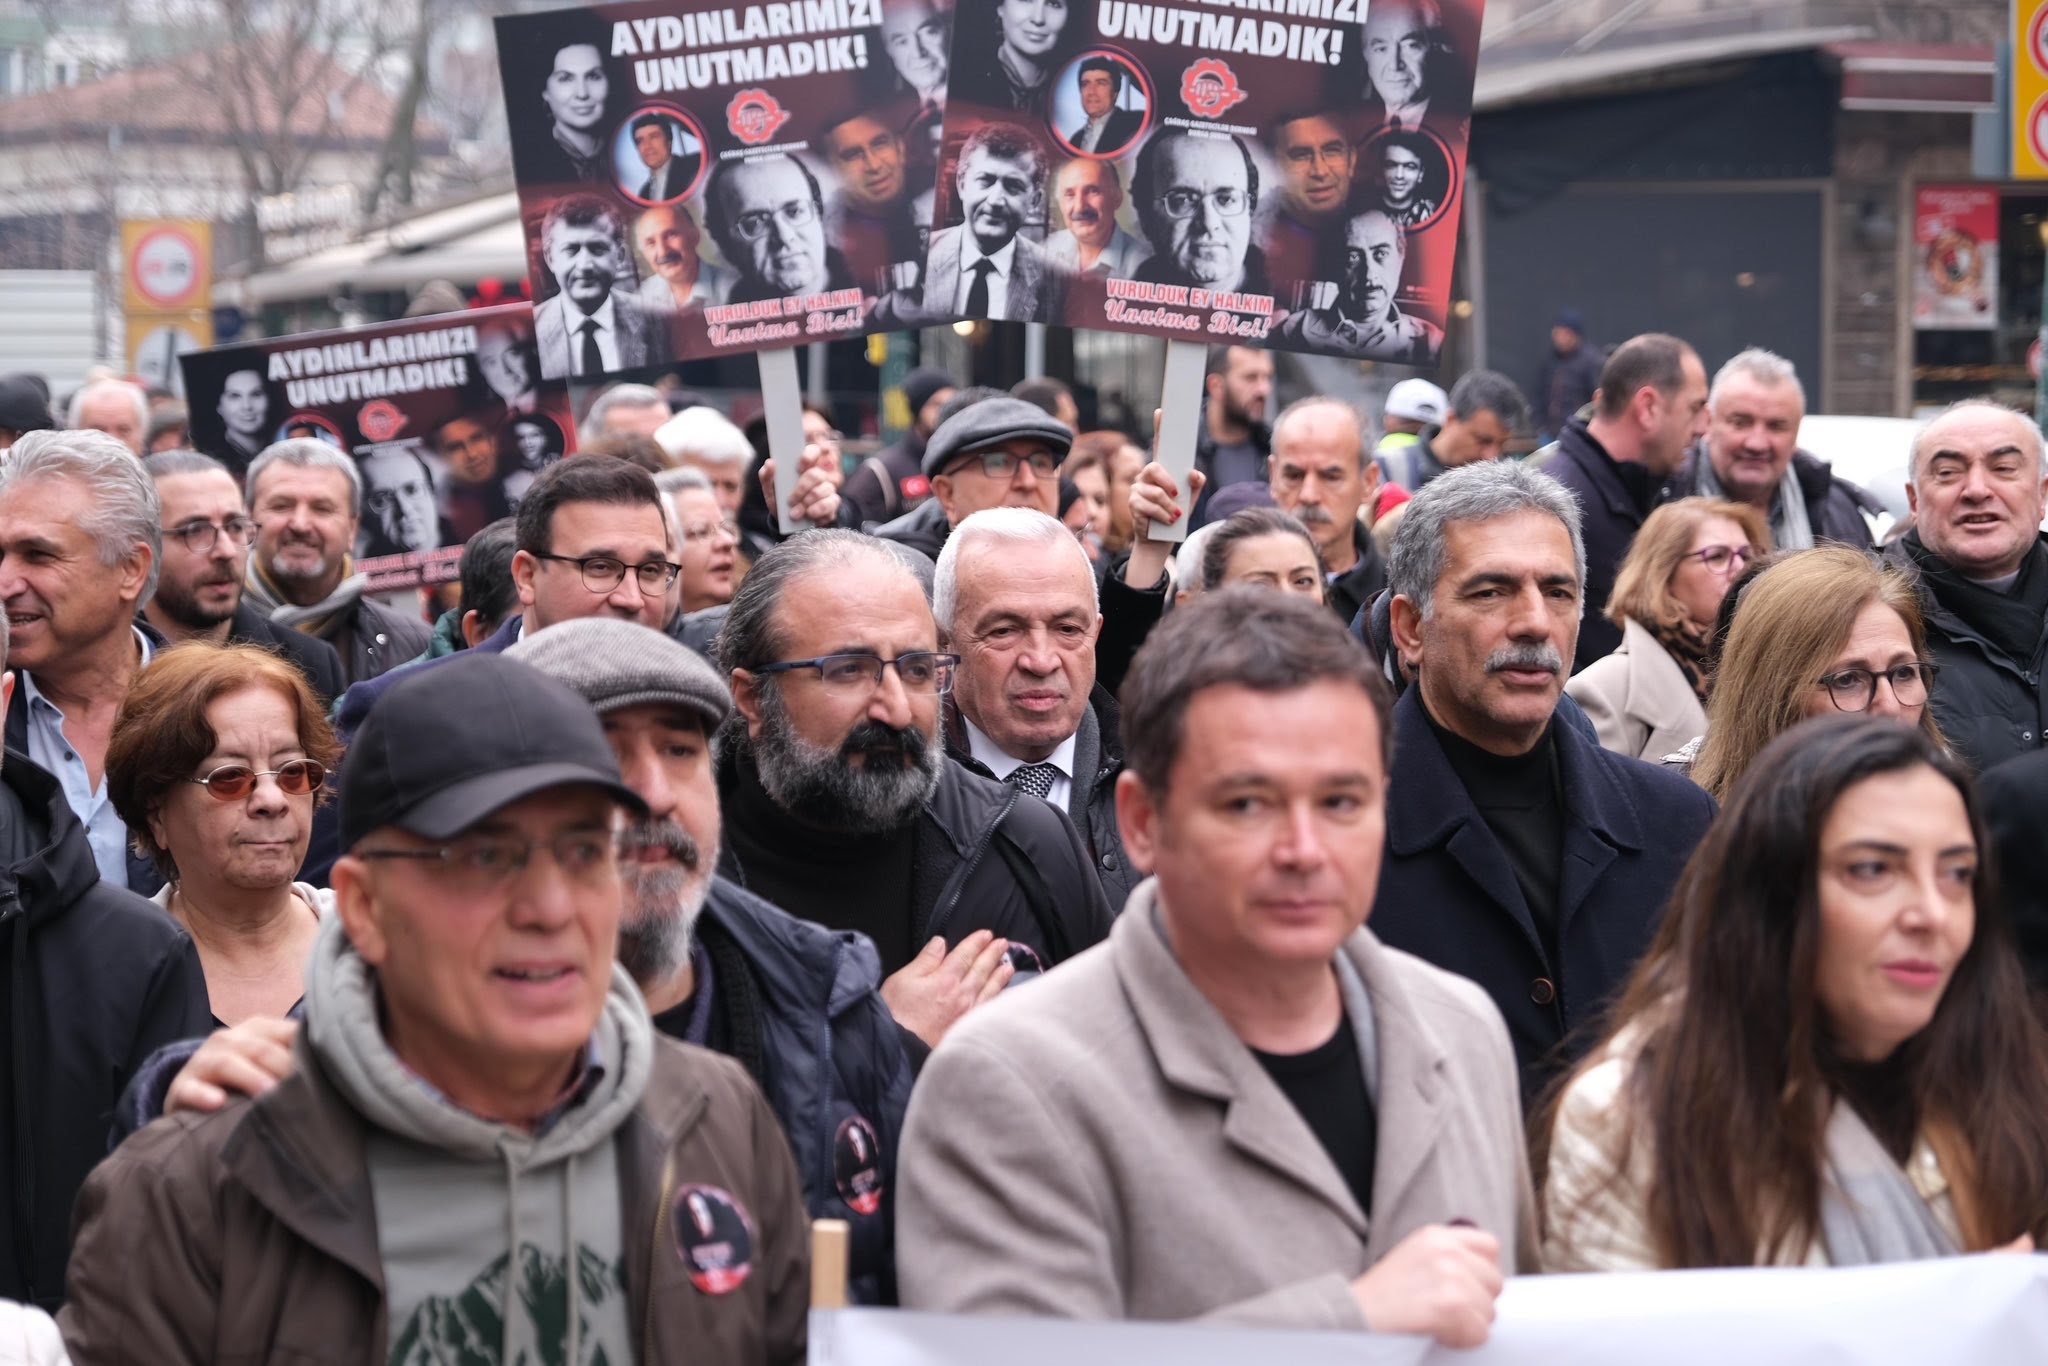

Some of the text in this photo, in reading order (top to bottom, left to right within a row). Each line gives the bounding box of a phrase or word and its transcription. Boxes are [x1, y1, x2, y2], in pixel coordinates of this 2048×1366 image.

[611, 0, 884, 57] AYDINLARIMIZI
[1097, 0, 1344, 66] UNUTMADIK!
[634, 34, 868, 95] UNUTMADIK!
[704, 287, 863, 326] VURULDUK EY HALKIM
[1104, 299, 1273, 339] Unutma Bizi!
[1106, 278, 1274, 315] VURULDUK EY HALKIM
[268, 325, 478, 381] AYDINLARIMIZI
[707, 321, 800, 347] Unutma
[286, 357, 468, 408] UNUTMADIK!
